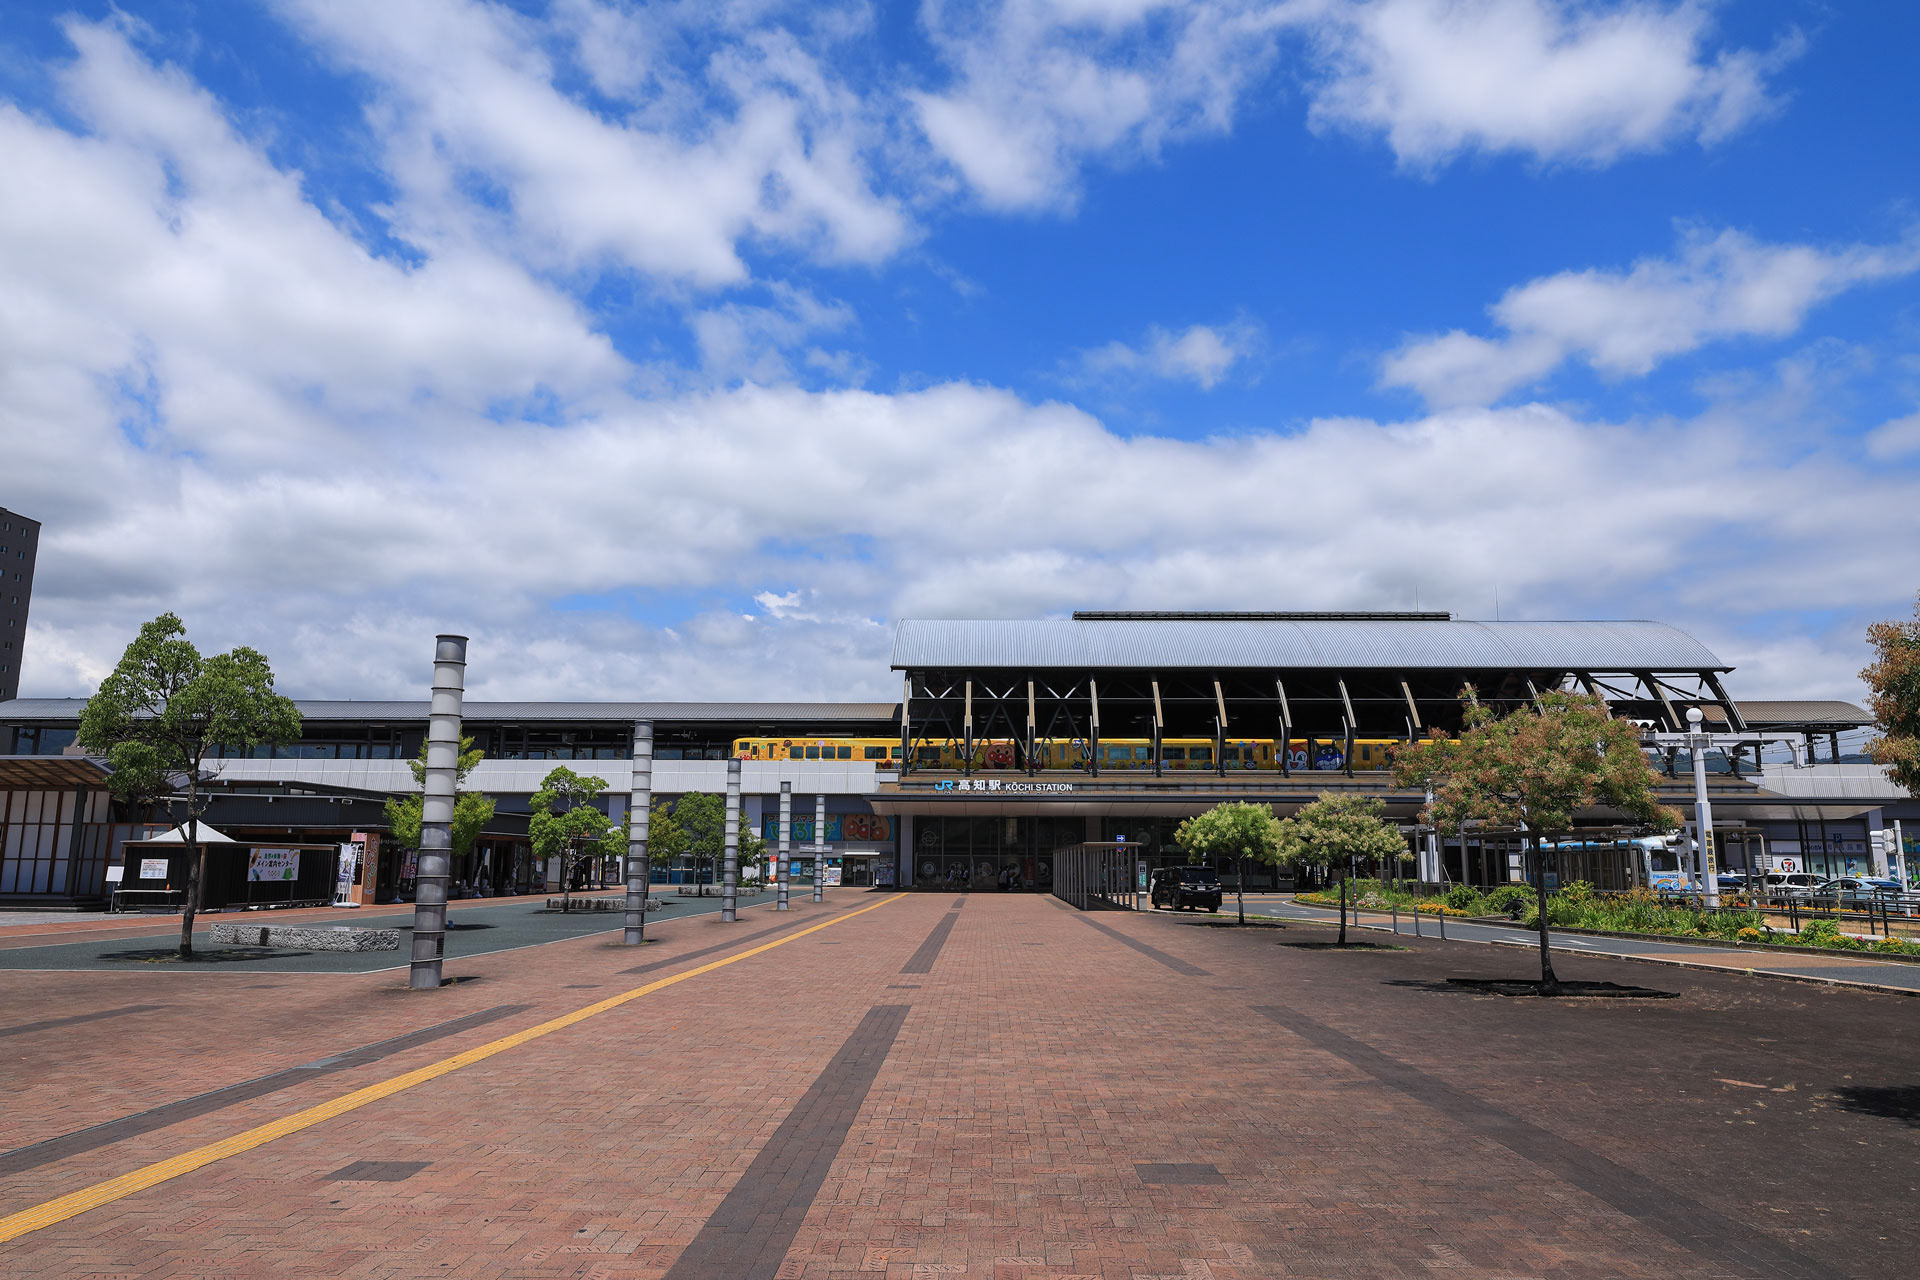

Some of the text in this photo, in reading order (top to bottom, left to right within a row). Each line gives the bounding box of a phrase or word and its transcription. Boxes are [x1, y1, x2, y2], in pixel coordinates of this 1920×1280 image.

[935, 779, 1001, 791] JR 高知駅
[1035, 783, 1073, 791] STATION
